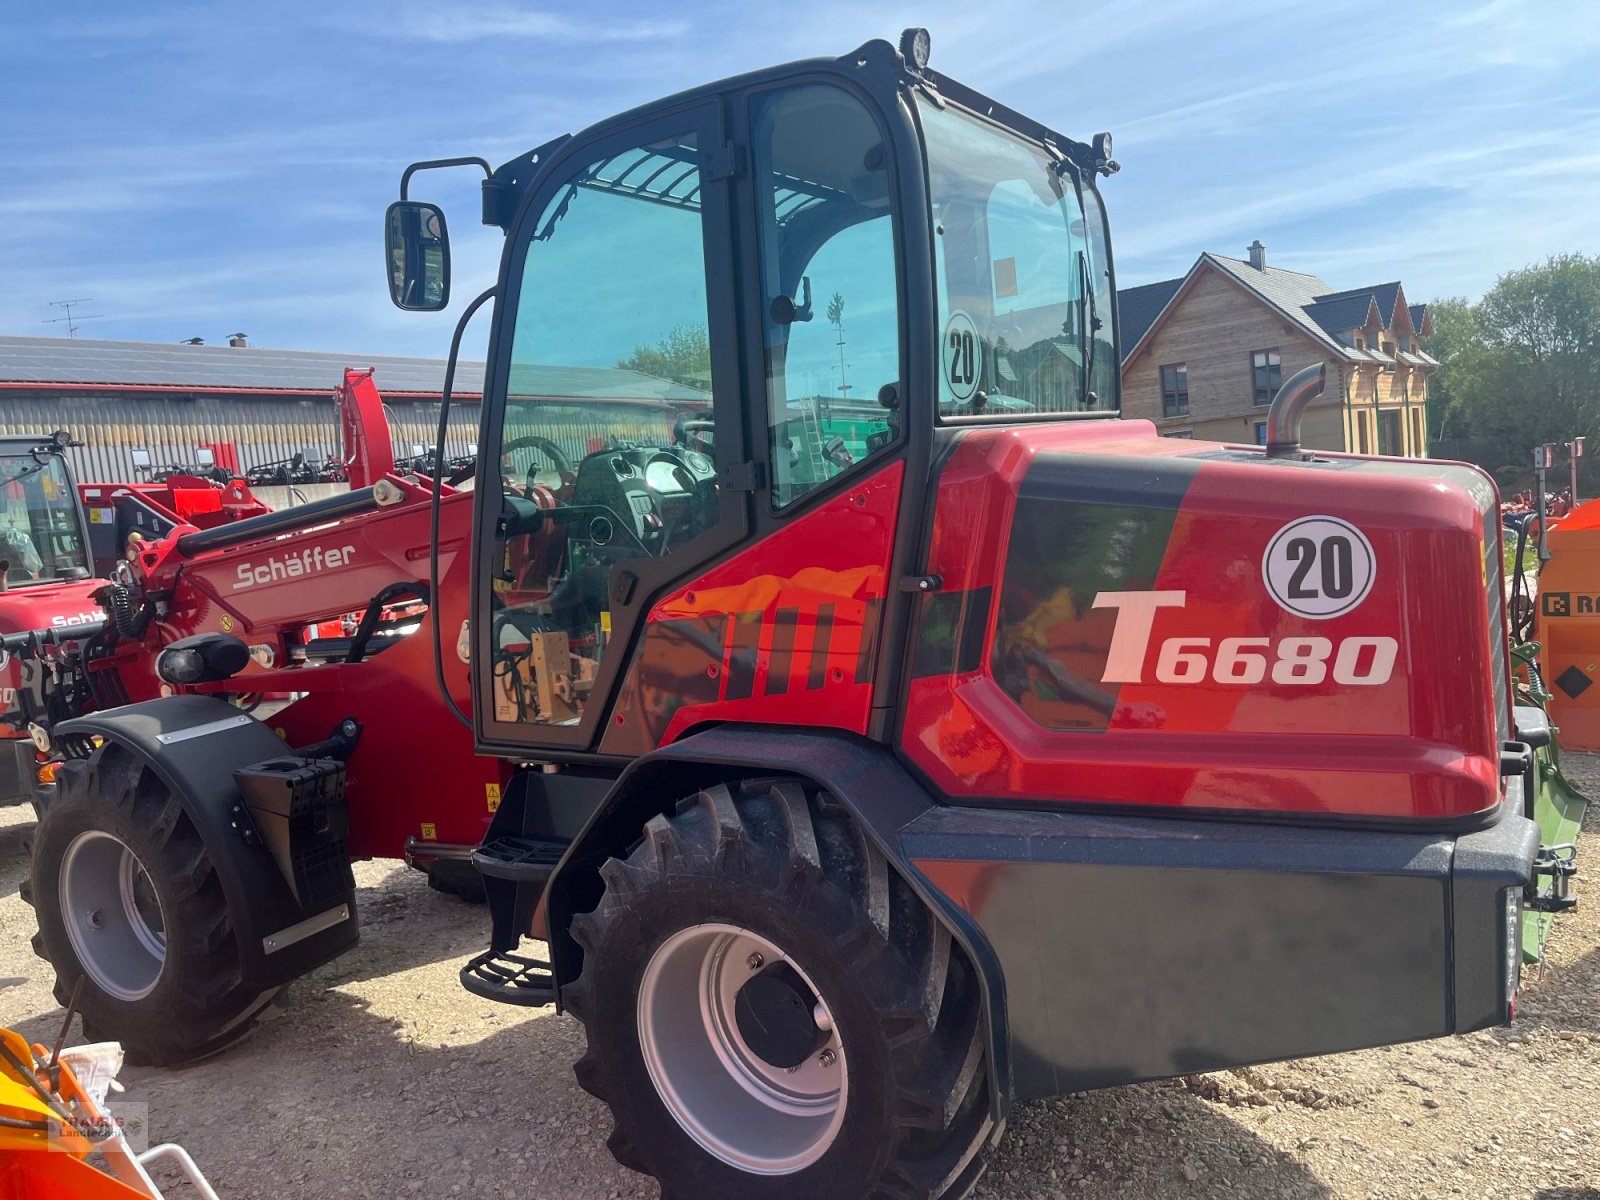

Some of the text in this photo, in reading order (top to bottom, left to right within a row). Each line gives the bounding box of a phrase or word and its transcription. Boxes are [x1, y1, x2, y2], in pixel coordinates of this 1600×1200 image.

[949, 328, 975, 385] 20
[232, 545, 356, 590] Schäffer
[1286, 535, 1354, 600] 20
[1091, 589, 1399, 686] T6680
